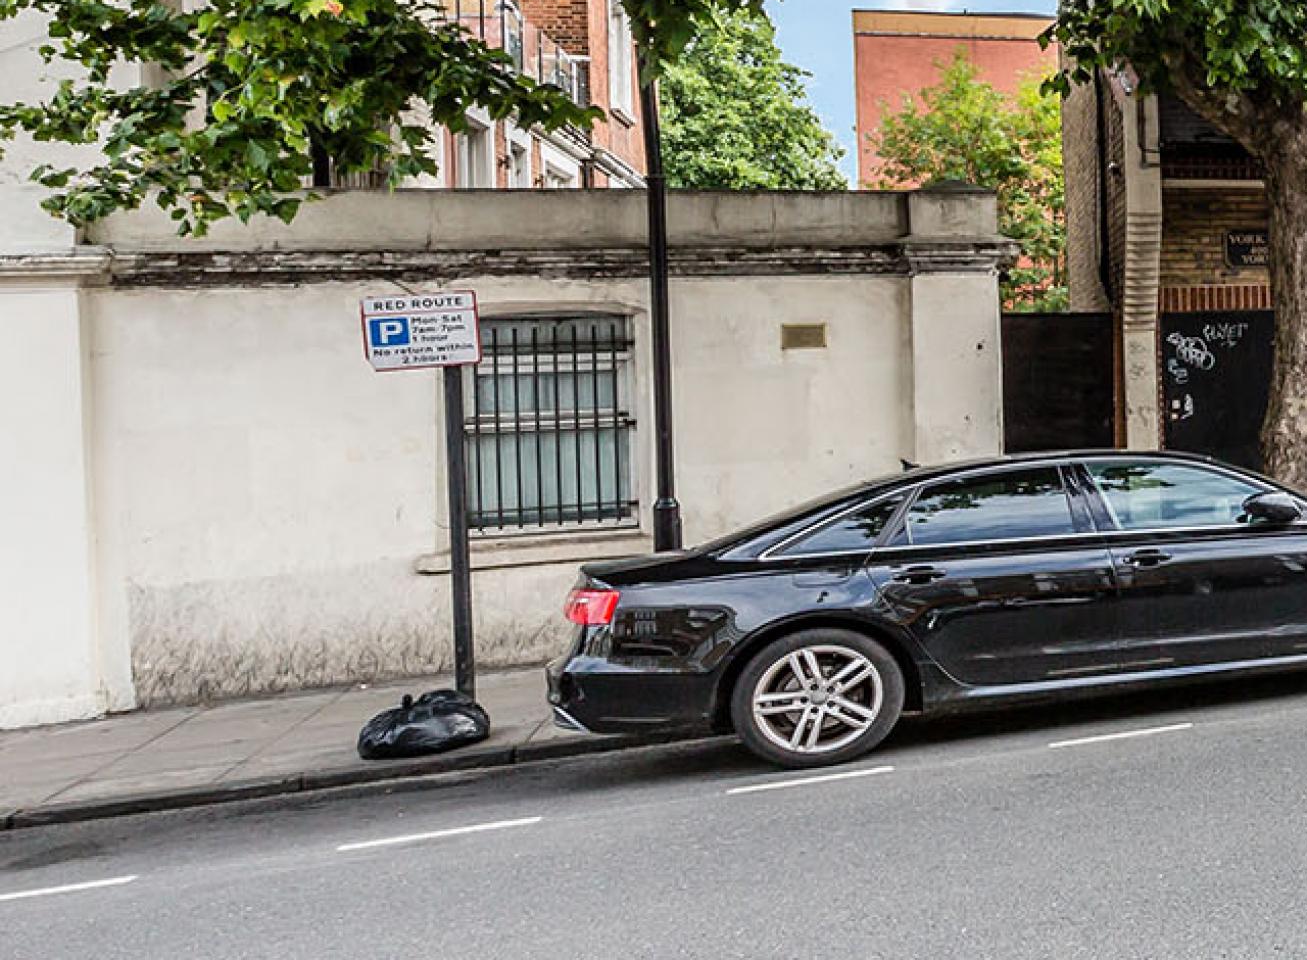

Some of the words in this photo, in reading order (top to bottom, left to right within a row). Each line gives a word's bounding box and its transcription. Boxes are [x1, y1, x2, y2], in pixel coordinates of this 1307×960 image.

[373, 300, 406, 311] RED
[411, 296, 463, 308] ROUTE
[379, 322, 403, 344] P
